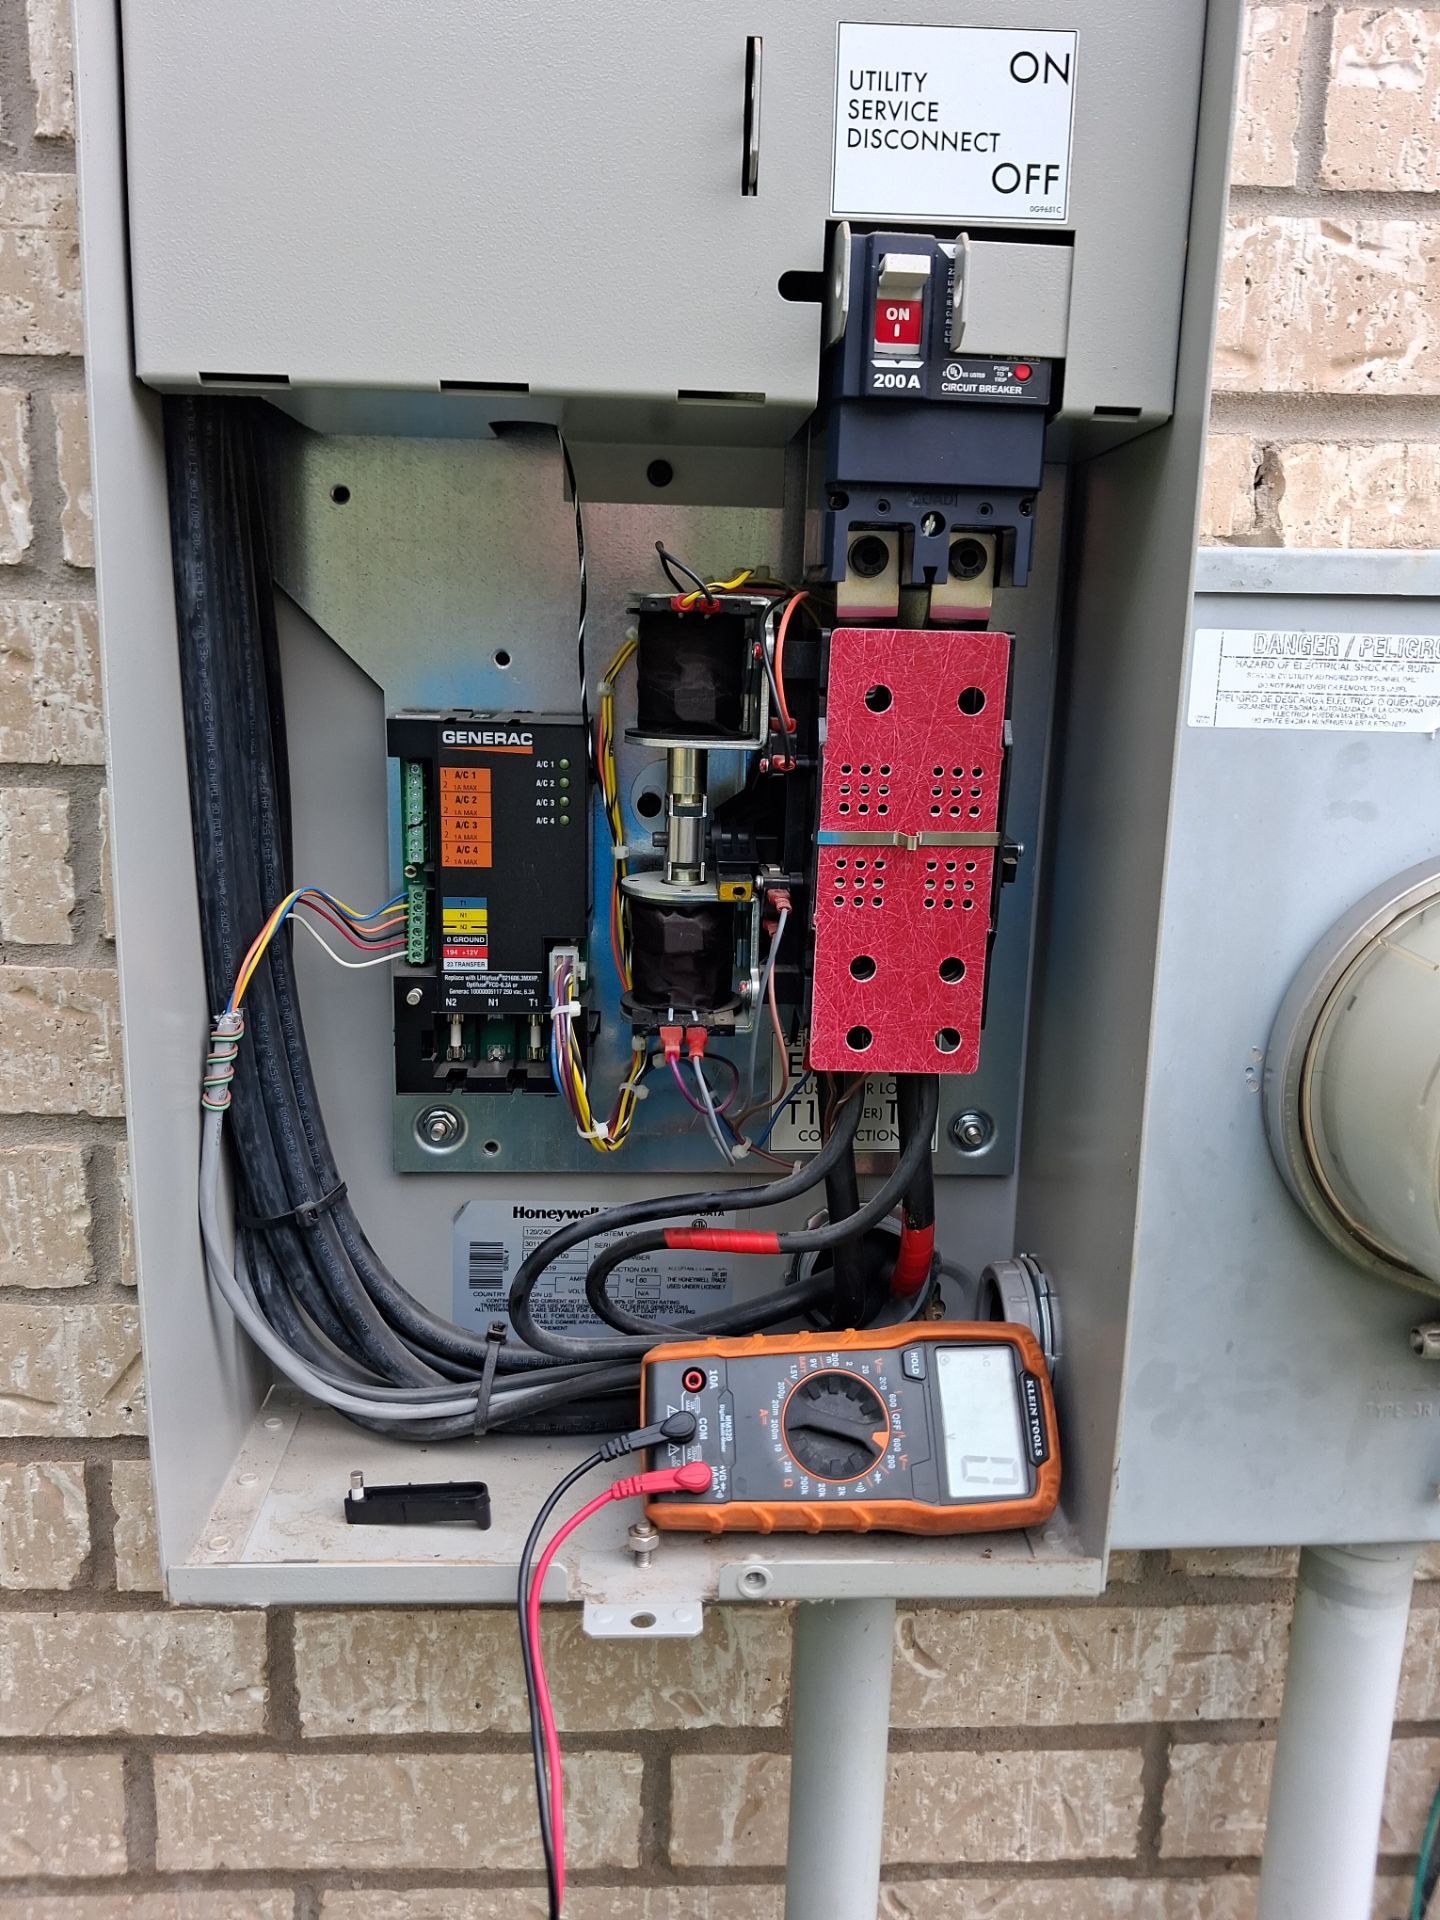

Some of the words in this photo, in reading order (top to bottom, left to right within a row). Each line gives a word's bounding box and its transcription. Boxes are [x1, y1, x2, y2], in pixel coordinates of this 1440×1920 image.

[1010, 51, 1070, 85] ON
[849, 69, 928, 93] UTILITY
[848, 98, 939, 122] SERVICE
[847, 127, 1001, 153] DISCONNECT
[992, 162, 1060, 195] OFF
[886, 307, 910, 321] ON
[873, 373, 921, 389] 200A
[941, 382, 978, 392] CIRCUIT
[978, 384, 1023, 394] BREAKER
[1252, 631, 1340, 657] DANGER
[1235, 660, 1275, 670] HAZARD
[1277, 661, 1291, 670] OF
[1293, 661, 1351, 671] ELECTRICAL
[1354, 662, 1388, 672] SHOCK
[442, 730, 533, 745] GENERAC
[536, 760, 548, 768] A/C
[550, 760, 555, 768] 1
[454, 770, 469, 779] A/C
[471, 770, 476, 778] 1
[536, 779, 548, 787] A/C
[550, 779, 555, 787] 2
[455, 796, 469, 804] A/C
[472, 796, 477, 804] 2
[536, 798, 548, 807] A/C
[550, 798, 555, 807] 3
[455, 820, 470, 829] A/C
[472, 821, 478, 829] 3
[536, 816, 548, 825] A/C
[550, 816, 555, 825] 4
[456, 845, 470, 854] A/C
[472, 846, 478, 854] 4
[445, 998, 457, 1006] N2
[488, 998, 499, 1006] N1
[529, 998, 538, 1006] T1
[862, 1364, 870, 1375] 20
[910, 1352, 920, 1375] HOLD
[708, 1369, 719, 1389] 10A
[790, 1364, 798, 1380] 1.5V
[1026, 1380, 1038, 1416] KLEIN
[771, 1399, 779, 1416] 20m
[699, 1417, 708, 1440] COM
[891, 1413, 902, 1430] OFF
[770, 1419, 779, 1440] 200m
[893, 1437, 902, 1452] 600
[1031, 1418, 1043, 1457] TOOLS
[773, 1443, 782, 1452] 10
[783, 1461, 792, 1473] 2M
[887, 1454, 896, 1469] 200
